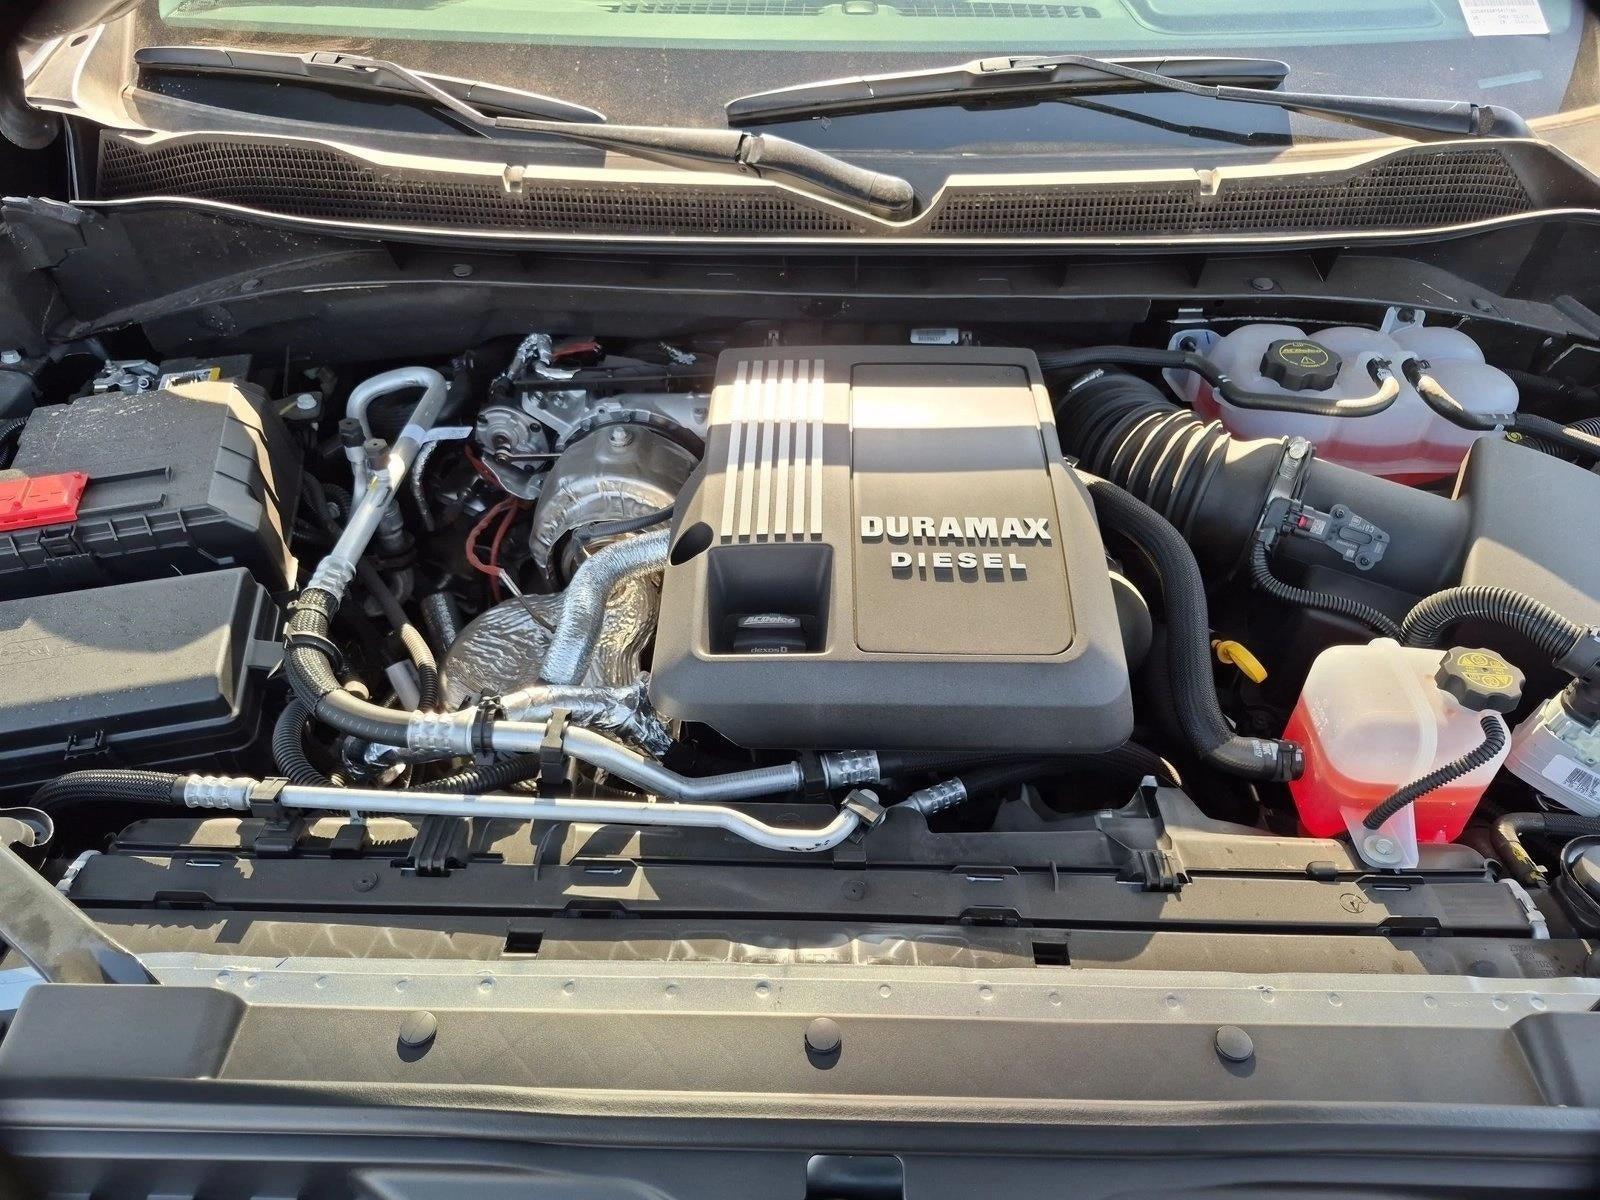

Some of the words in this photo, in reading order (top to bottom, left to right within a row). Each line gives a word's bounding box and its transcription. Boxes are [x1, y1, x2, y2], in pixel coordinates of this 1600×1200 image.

[861, 515, 1052, 541] DURAMAX
[890, 551, 1027, 570] DIESEL
[743, 615, 797, 625] ACDelco
